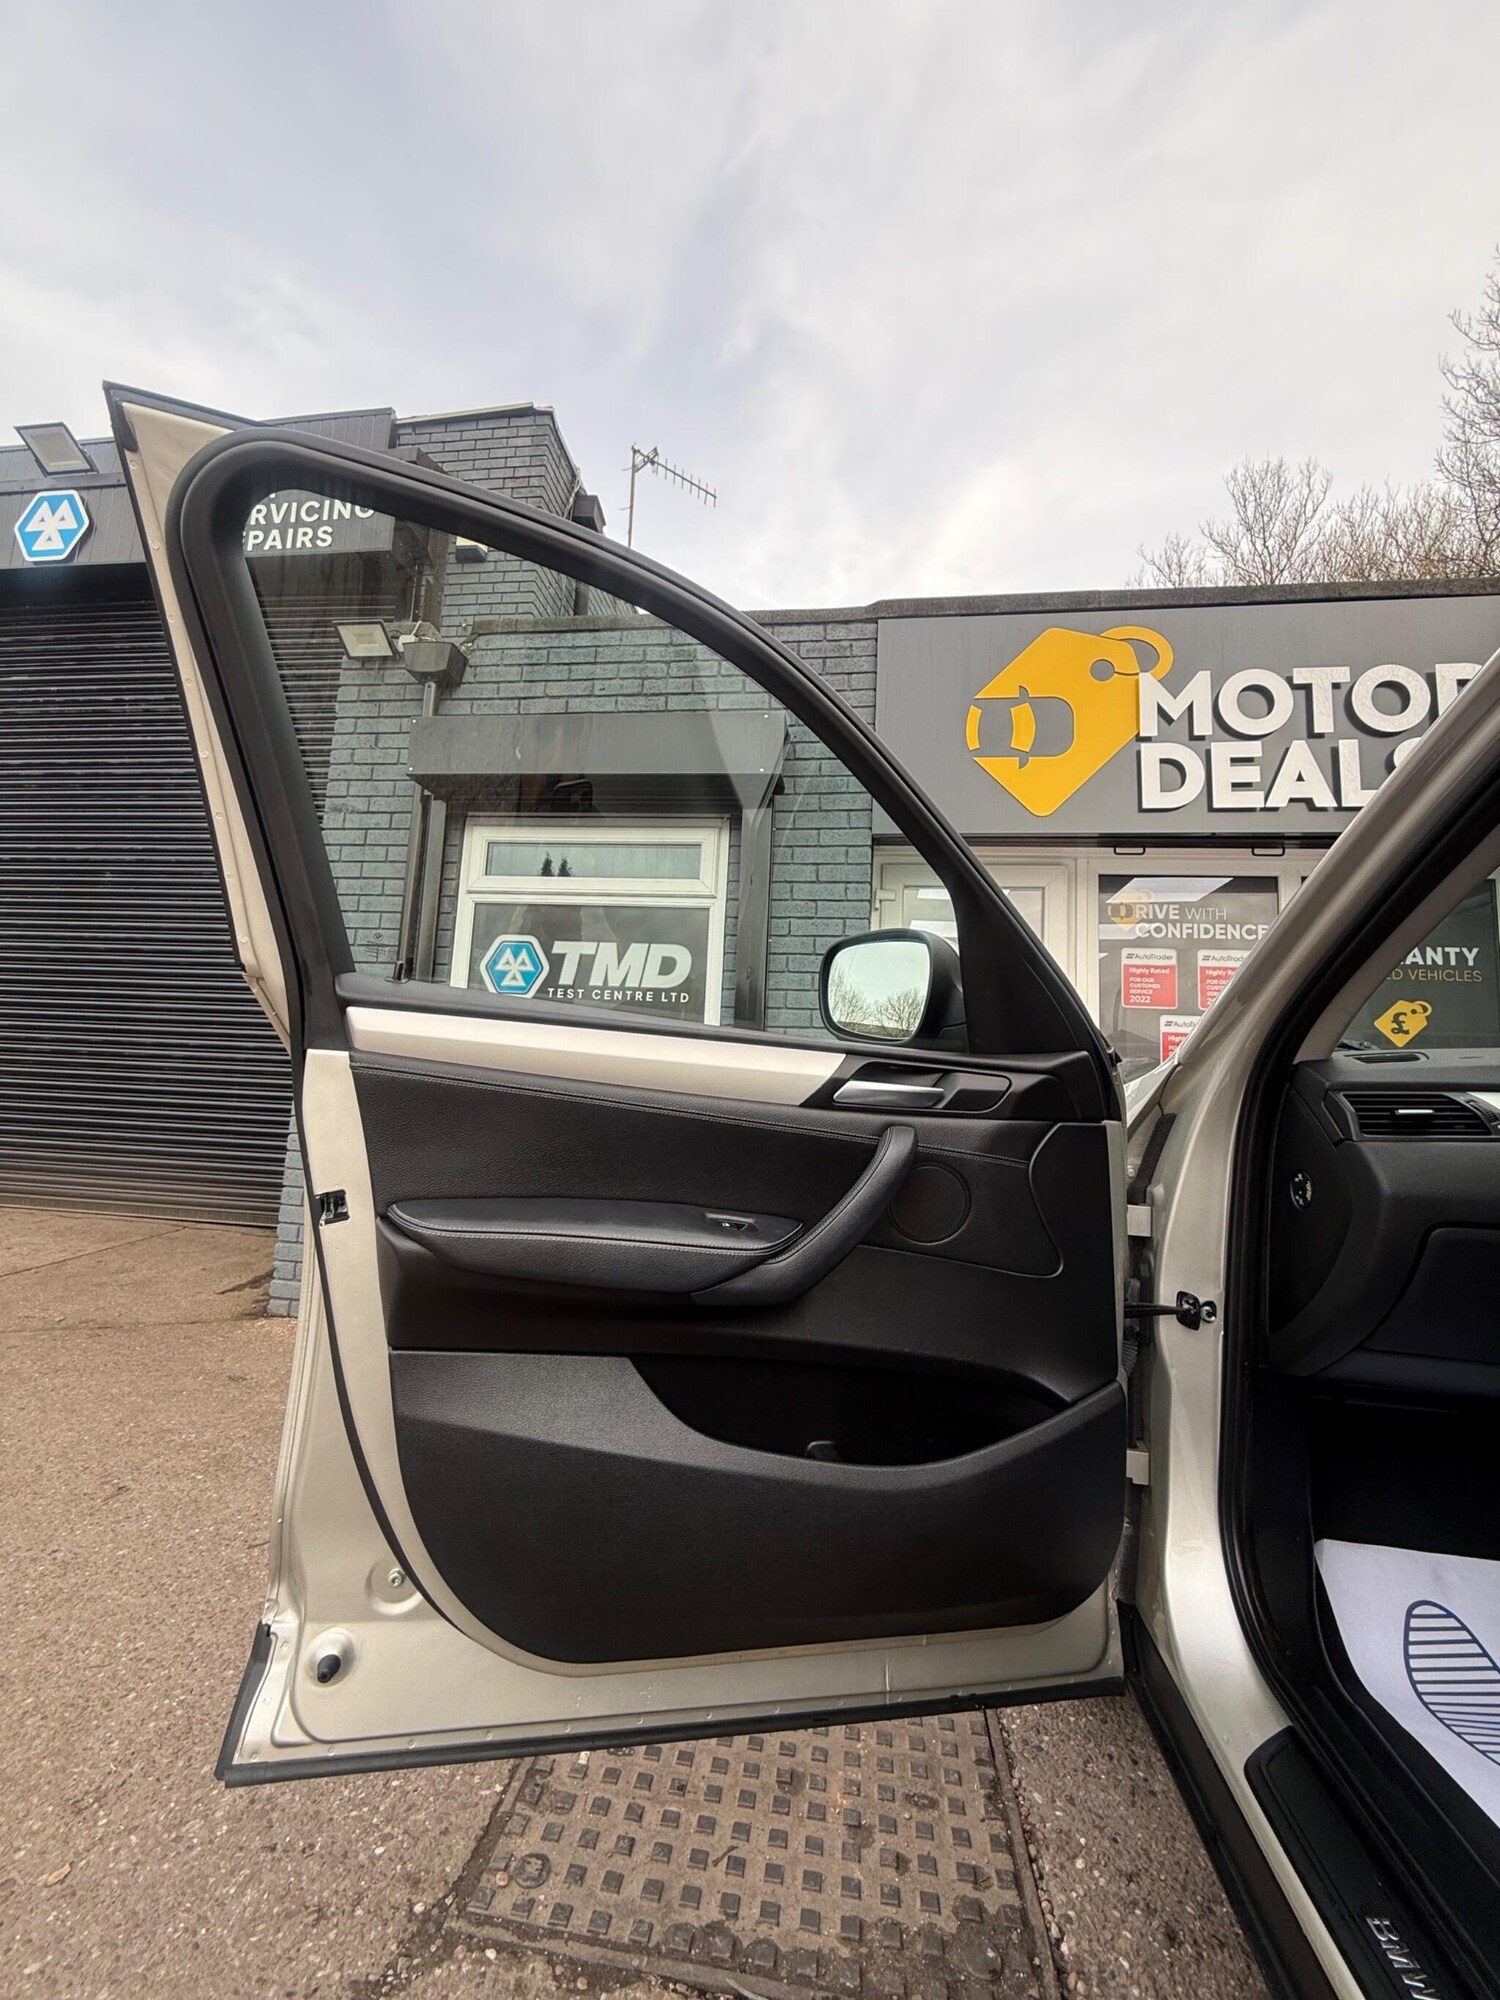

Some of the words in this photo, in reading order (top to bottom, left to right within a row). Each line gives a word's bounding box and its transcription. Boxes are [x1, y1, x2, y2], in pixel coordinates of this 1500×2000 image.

[243, 525, 334, 551] PAIRS
[1140, 737, 1423, 810] DEAL
[1185, 907, 1227, 920] WITH
[1400, 946, 1480, 966] ANTY
[552, 940, 692, 989] TMD
[1129, 967, 1149, 975] Highly
[1408, 969, 1483, 982] VEHICLES
[547, 987, 585, 999] TEST
[591, 989, 654, 1001] CENTRE
[661, 991, 689, 1003] LTD
[1129, 995, 1152, 1003] 2022
